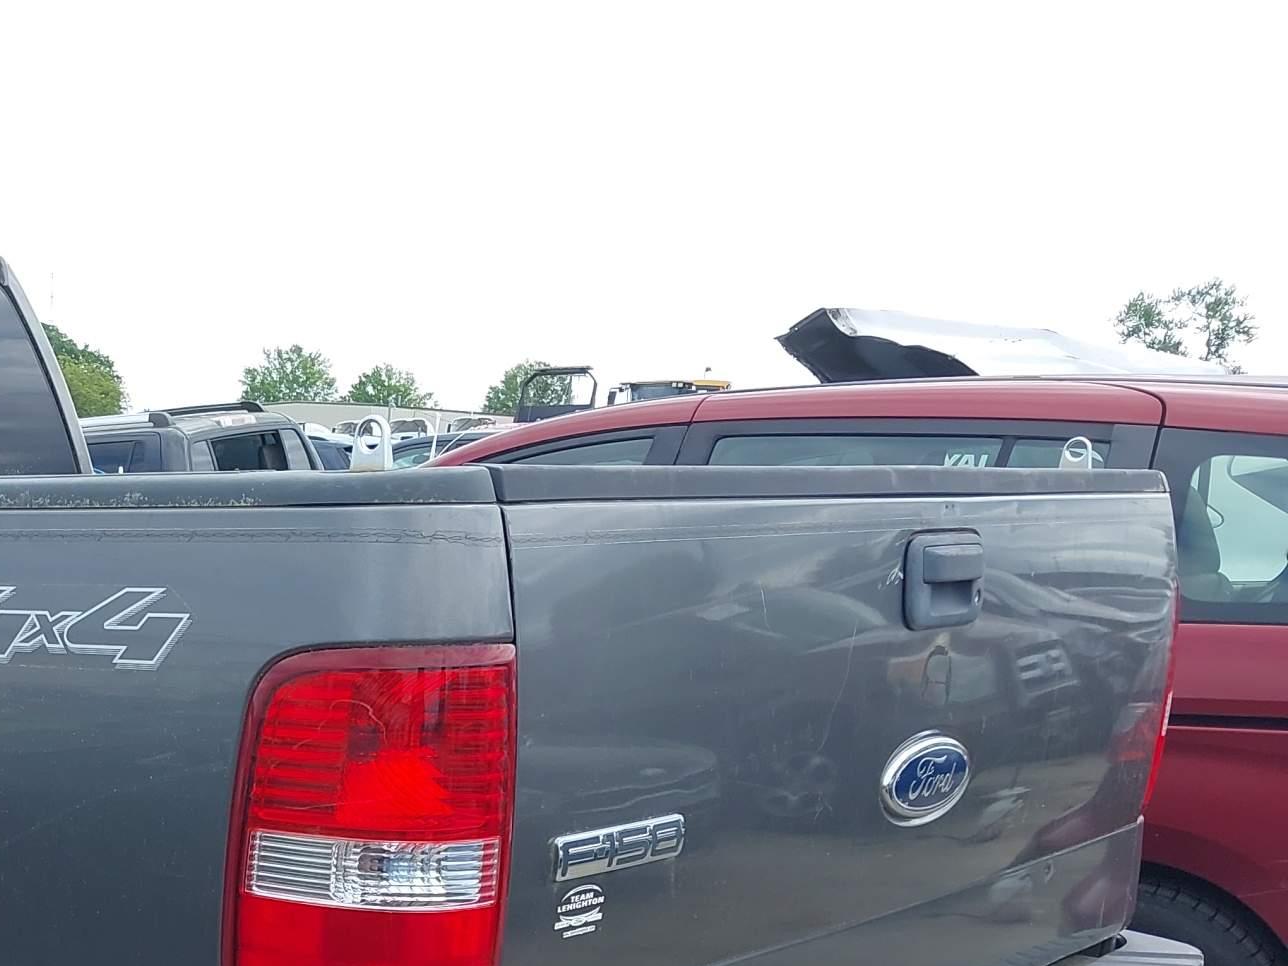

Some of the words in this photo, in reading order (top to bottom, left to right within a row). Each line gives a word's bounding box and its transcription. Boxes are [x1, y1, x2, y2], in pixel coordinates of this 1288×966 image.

[909, 755, 957, 800] Ford
[559, 820, 684, 877] F-150
[557, 896, 605, 913] LEHIGHTON
[570, 892, 594, 903] TEAM
